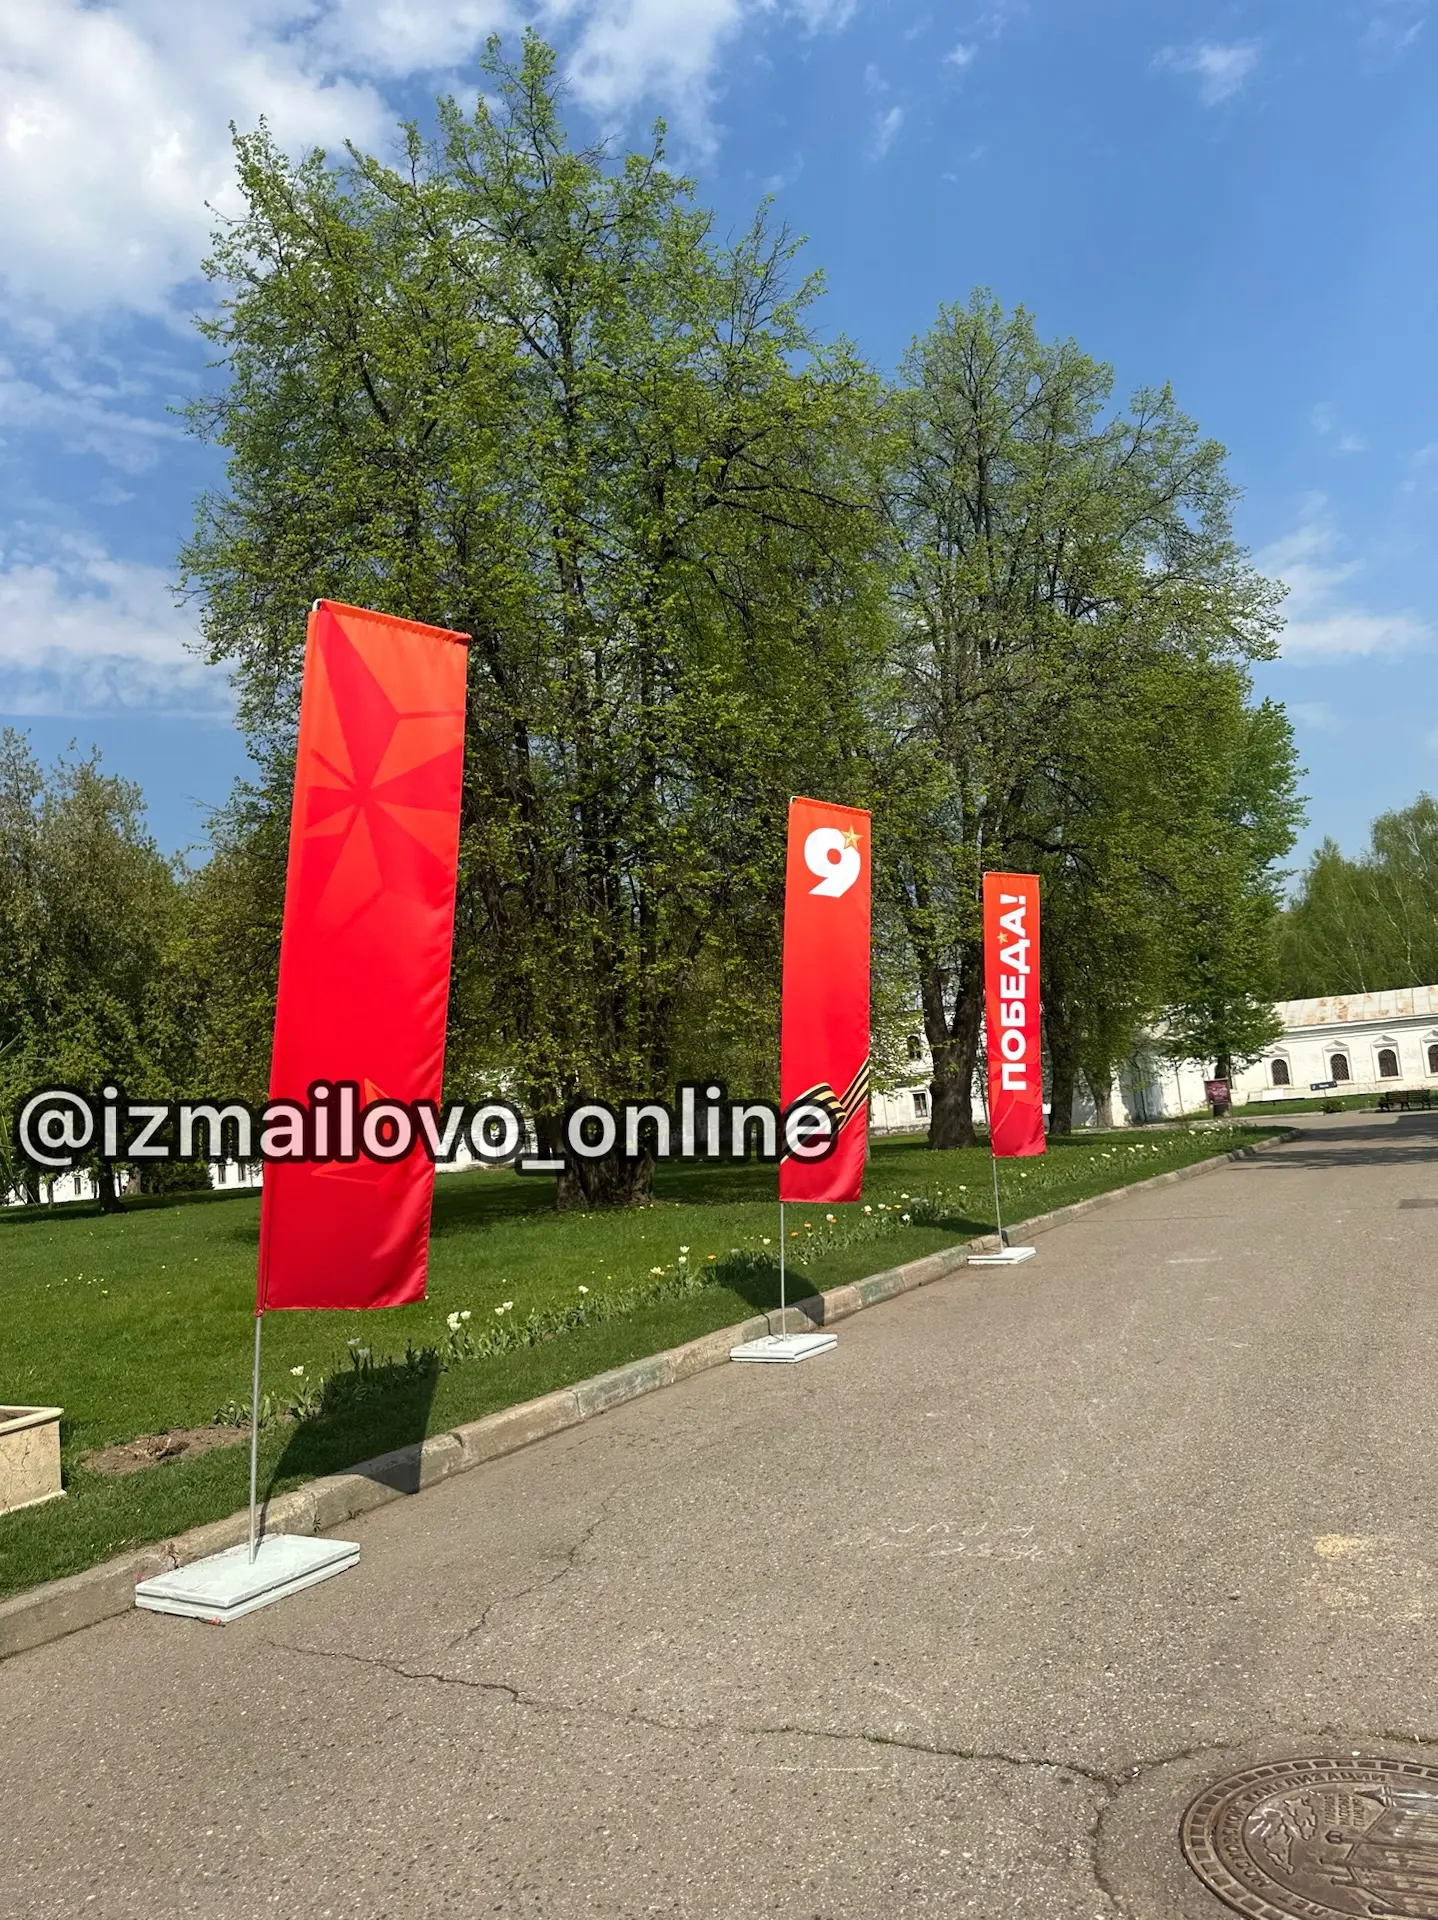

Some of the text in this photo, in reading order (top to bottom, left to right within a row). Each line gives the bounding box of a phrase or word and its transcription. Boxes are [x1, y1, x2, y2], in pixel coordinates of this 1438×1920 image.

[804, 827, 861, 898] 9
[999, 894, 1031, 1091] ПОБЕДА!
[1242, 1771, 1387, 1804] КАНАЛИЗАЦИИ
